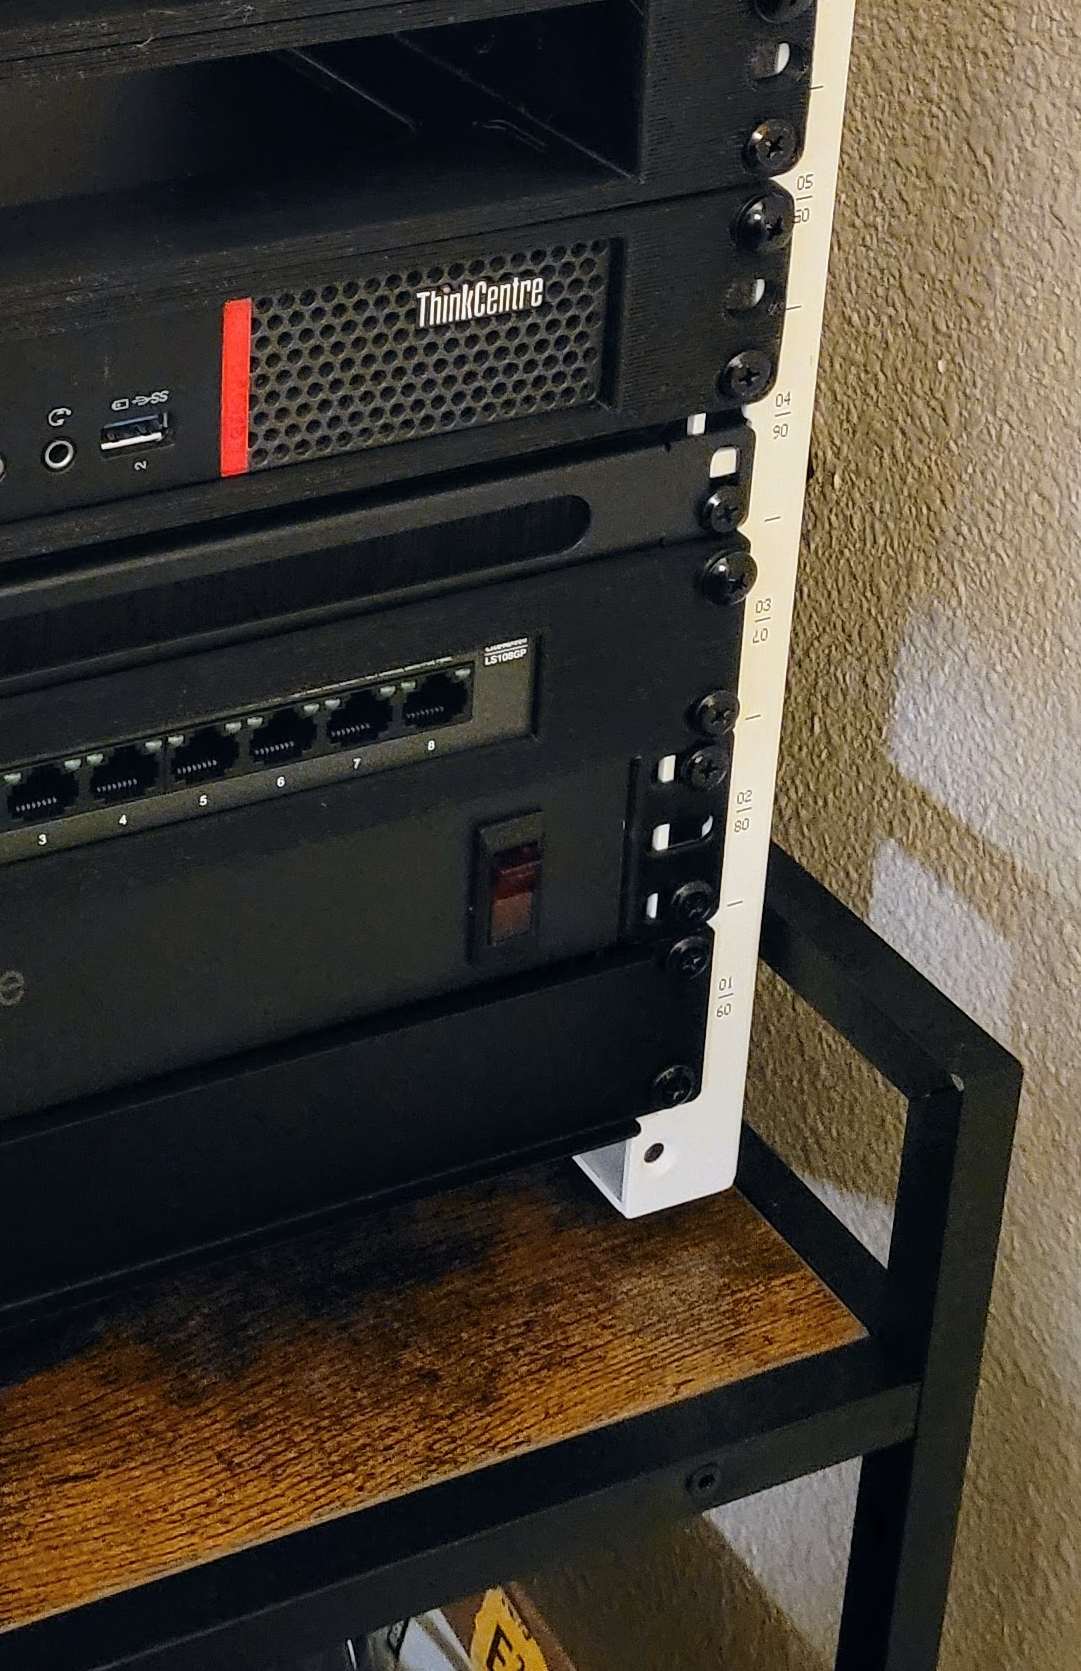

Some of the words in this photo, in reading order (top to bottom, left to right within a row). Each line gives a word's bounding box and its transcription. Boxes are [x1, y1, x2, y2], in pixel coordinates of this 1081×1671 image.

[416, 275, 544, 328] ThinkCentre
[38, 834, 47, 845] 3
[118, 814, 127, 826] 4
[199, 795, 208, 807] 5
[276, 776, 285, 788] 6
[353, 758, 362, 770] 7
[427, 740, 436, 752] 8
